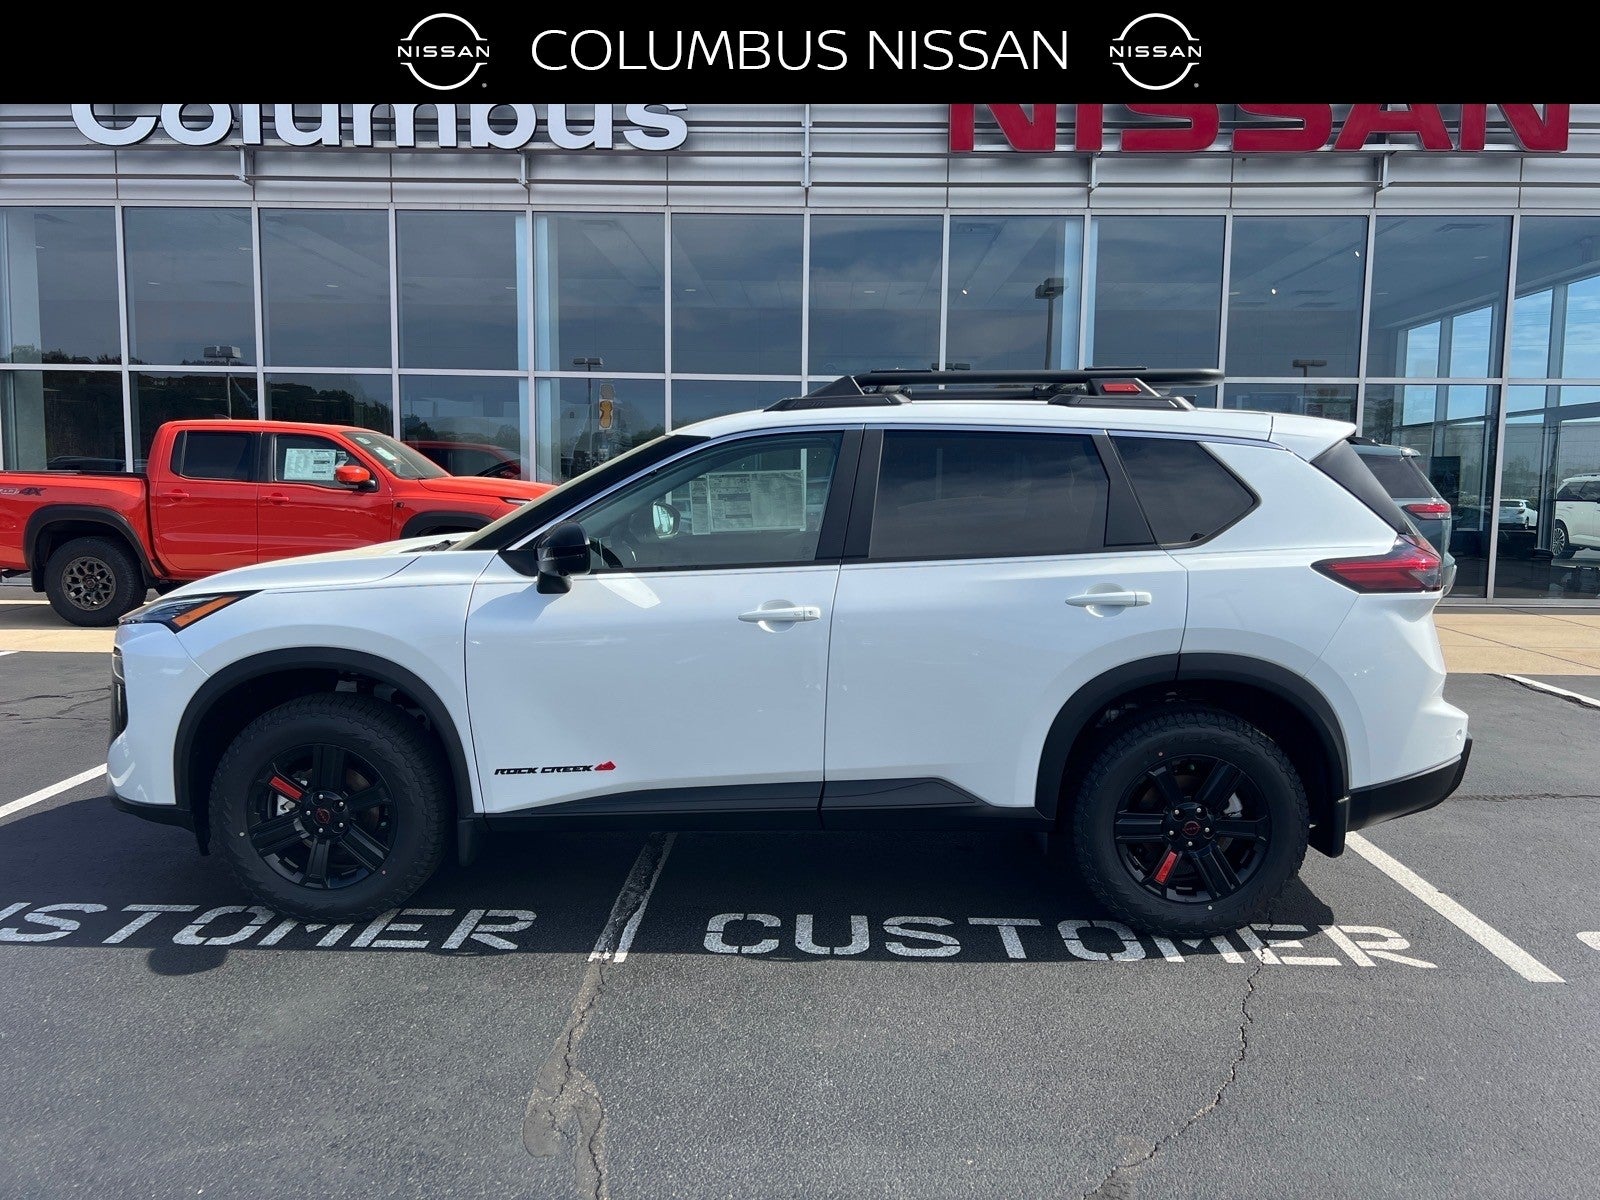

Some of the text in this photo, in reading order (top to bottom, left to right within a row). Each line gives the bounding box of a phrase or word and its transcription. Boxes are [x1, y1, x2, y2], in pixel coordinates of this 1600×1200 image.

[70, 103, 689, 151] Columbus
[949, 103, 1570, 153] NISSAN
[494, 764, 594, 775] ROCK CREEK
[0, 902, 538, 950] STOMER
[703, 913, 1439, 969] CUSTOMER
